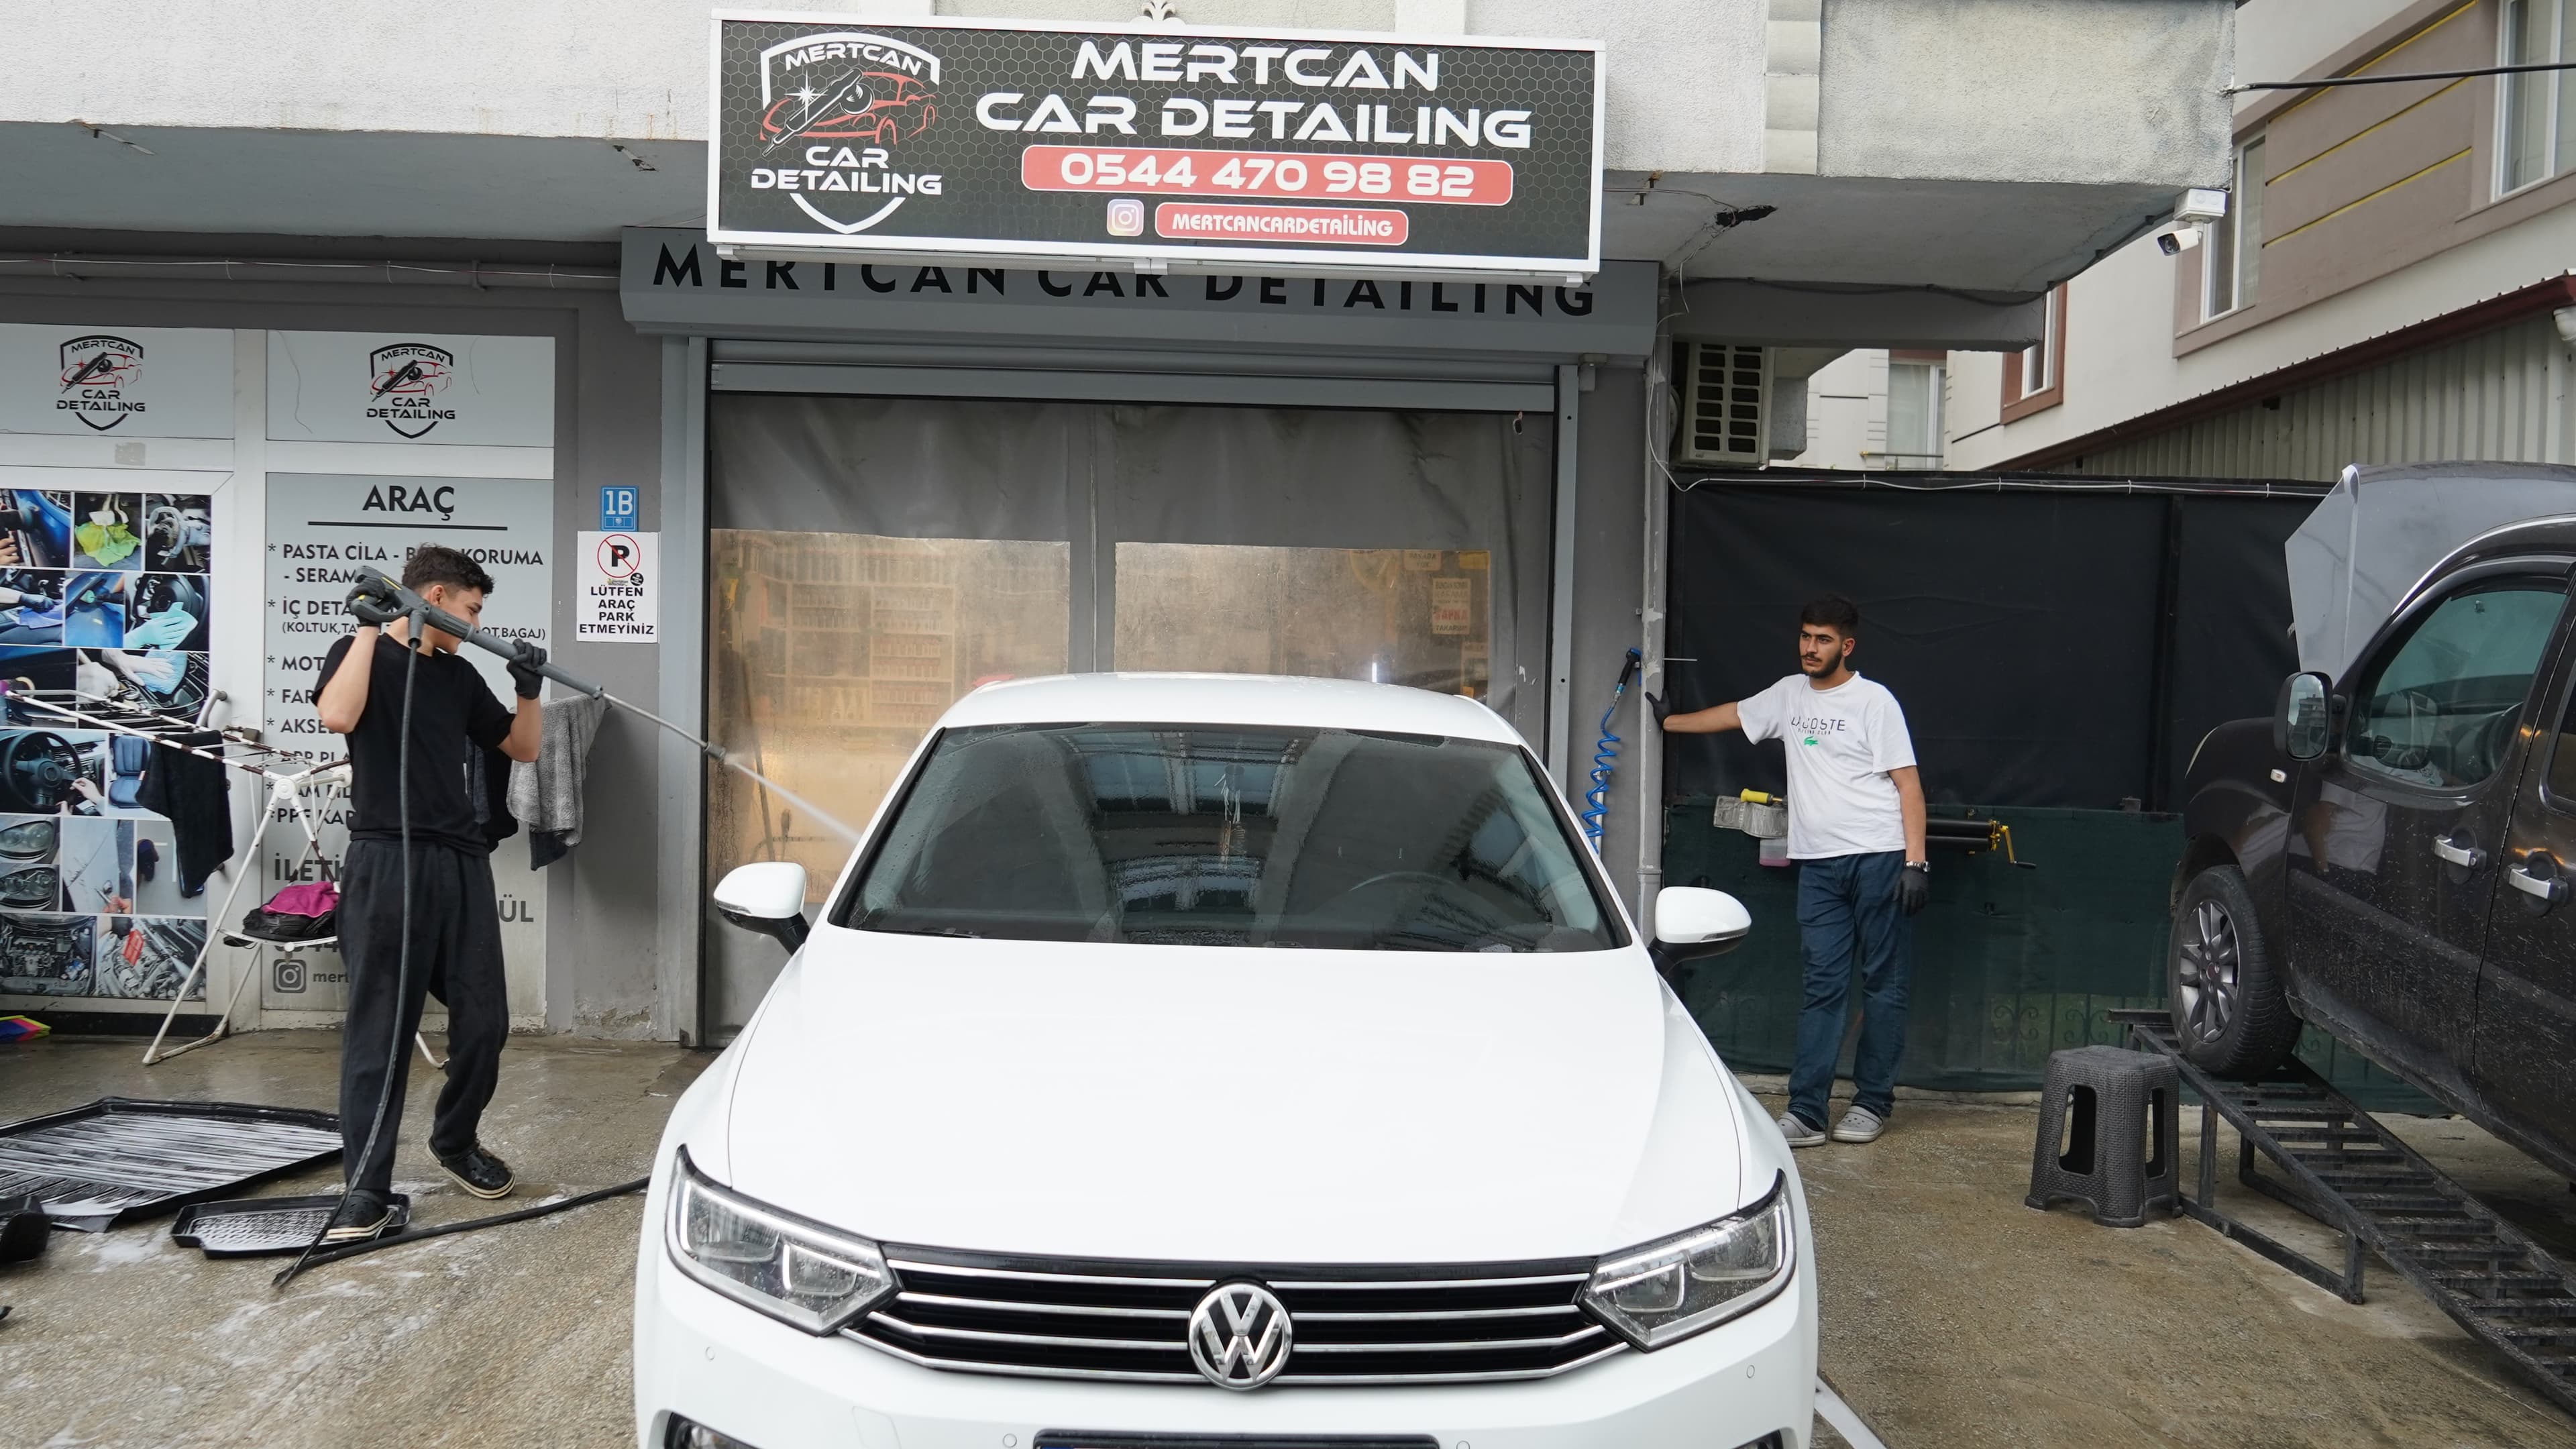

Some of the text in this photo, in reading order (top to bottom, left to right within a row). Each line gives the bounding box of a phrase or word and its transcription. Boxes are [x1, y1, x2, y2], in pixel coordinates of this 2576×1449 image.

[786, 42, 922, 76] MERTCAN
[1071, 41, 1439, 91] MERTCAN
[975, 92, 1532, 149] CAR DETAILING
[805, 146, 889, 169] CAR
[750, 168, 943, 195] DETAILING
[1060, 153, 1474, 198] 0544 470 98 82
[71, 339, 136, 355] MERTCAN
[381, 347, 445, 363] MERTCAN
[82, 389, 121, 400] CAR
[392, 397, 431, 407] CAR
[56, 400, 146, 412] DETAILING
[366, 408, 455, 420] DETAILING
[362, 484, 455, 521] ARAÇ
[606, 490, 633, 515] 1B
[283, 543, 339, 560] PASTA
[345, 541, 388, 561] CİLA
[611, 545, 630, 568] P
[296, 567, 356, 584] SERAM
[591, 584, 643, 596] LÜTFEN
[282, 596, 352, 619] İÇ DETA
[598, 598, 636, 612] ARAÇ
[598, 612, 635, 622] PARK
[282, 622, 360, 635] (KOLTUK,TA
[579, 623, 654, 635] ETMEYİNİZ
[281, 655, 327, 671] MOT
[280, 718, 335, 734] AKSE
[274, 853, 341, 881] İLETİ
[498, 894, 534, 923] ÜL
[313, 971, 350, 983] mert
